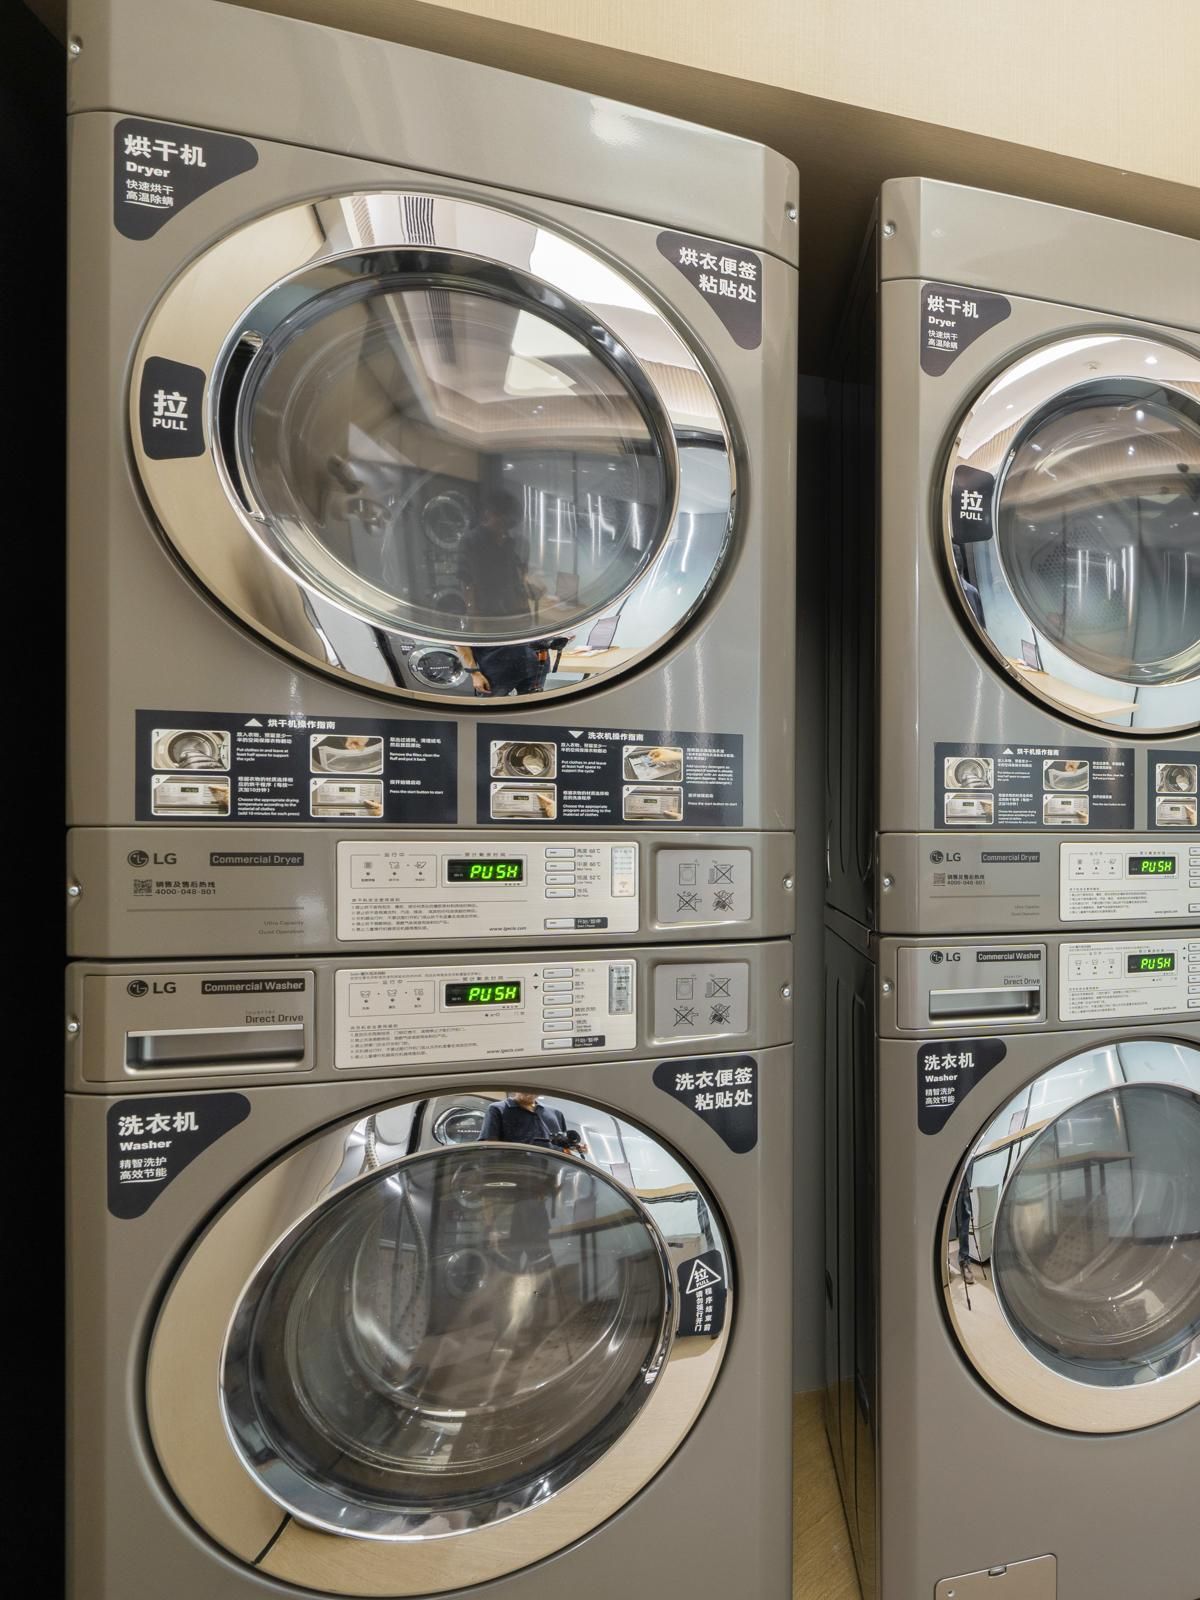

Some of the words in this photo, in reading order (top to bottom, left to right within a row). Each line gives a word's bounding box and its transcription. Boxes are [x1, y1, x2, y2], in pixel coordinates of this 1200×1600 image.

[124, 134, 207, 168] 烘干机
[126, 161, 170, 177] Dryer
[126, 179, 174, 195] 快速烘干
[679, 246, 756, 280] 烘衣便签
[699, 274, 756, 303] 粘贴处
[927, 294, 979, 318] 烘干机
[928, 316, 956, 327] Dryer
[153, 389, 188, 418] 拉
[152, 417, 188, 431] PULL
[961, 489, 983, 511] 拉
[960, 511, 982, 521] PULL
[267, 719, 336, 730] 烘干机操作指南
[153, 852, 177, 865] LG
[212, 855, 271, 864] Commercial
[273, 855, 301, 865] Dryer
[946, 852, 961, 862] LG
[982, 853, 1020, 861] Commercial
[1020, 853, 1039, 862] Dryer
[470, 864, 518, 879] PUSH
[1141, 861, 1172, 872] PUSH
[946, 952, 961, 962] LG
[978, 953, 1014, 961] Commercial
[1015, 952, 1040, 960] Washer
[1140, 957, 1172, 970] PUSH
[204, 982, 263, 992] Commercial
[264, 981, 303, 991] Washer
[1024, 977, 1040, 985] Drive
[153, 982, 177, 994] LG
[468, 986, 516, 1002] PUSH
[245, 1015, 276, 1024] Direct
[278, 1014, 304, 1023] Drive
[924, 1052, 975, 1071] 洗衣机
[675, 1067, 753, 1091] 洗衣便签
[925, 1074, 958, 1083] Washer
[694, 1089, 753, 1111] 粘贴处
[118, 1111, 199, 1136] 洗衣机
[119, 1140, 172, 1152] Washer
[119, 1156, 167, 1170] 精智洗护
[119, 1168, 168, 1180] 高效节能
[694, 1268, 709, 1283] 拉
